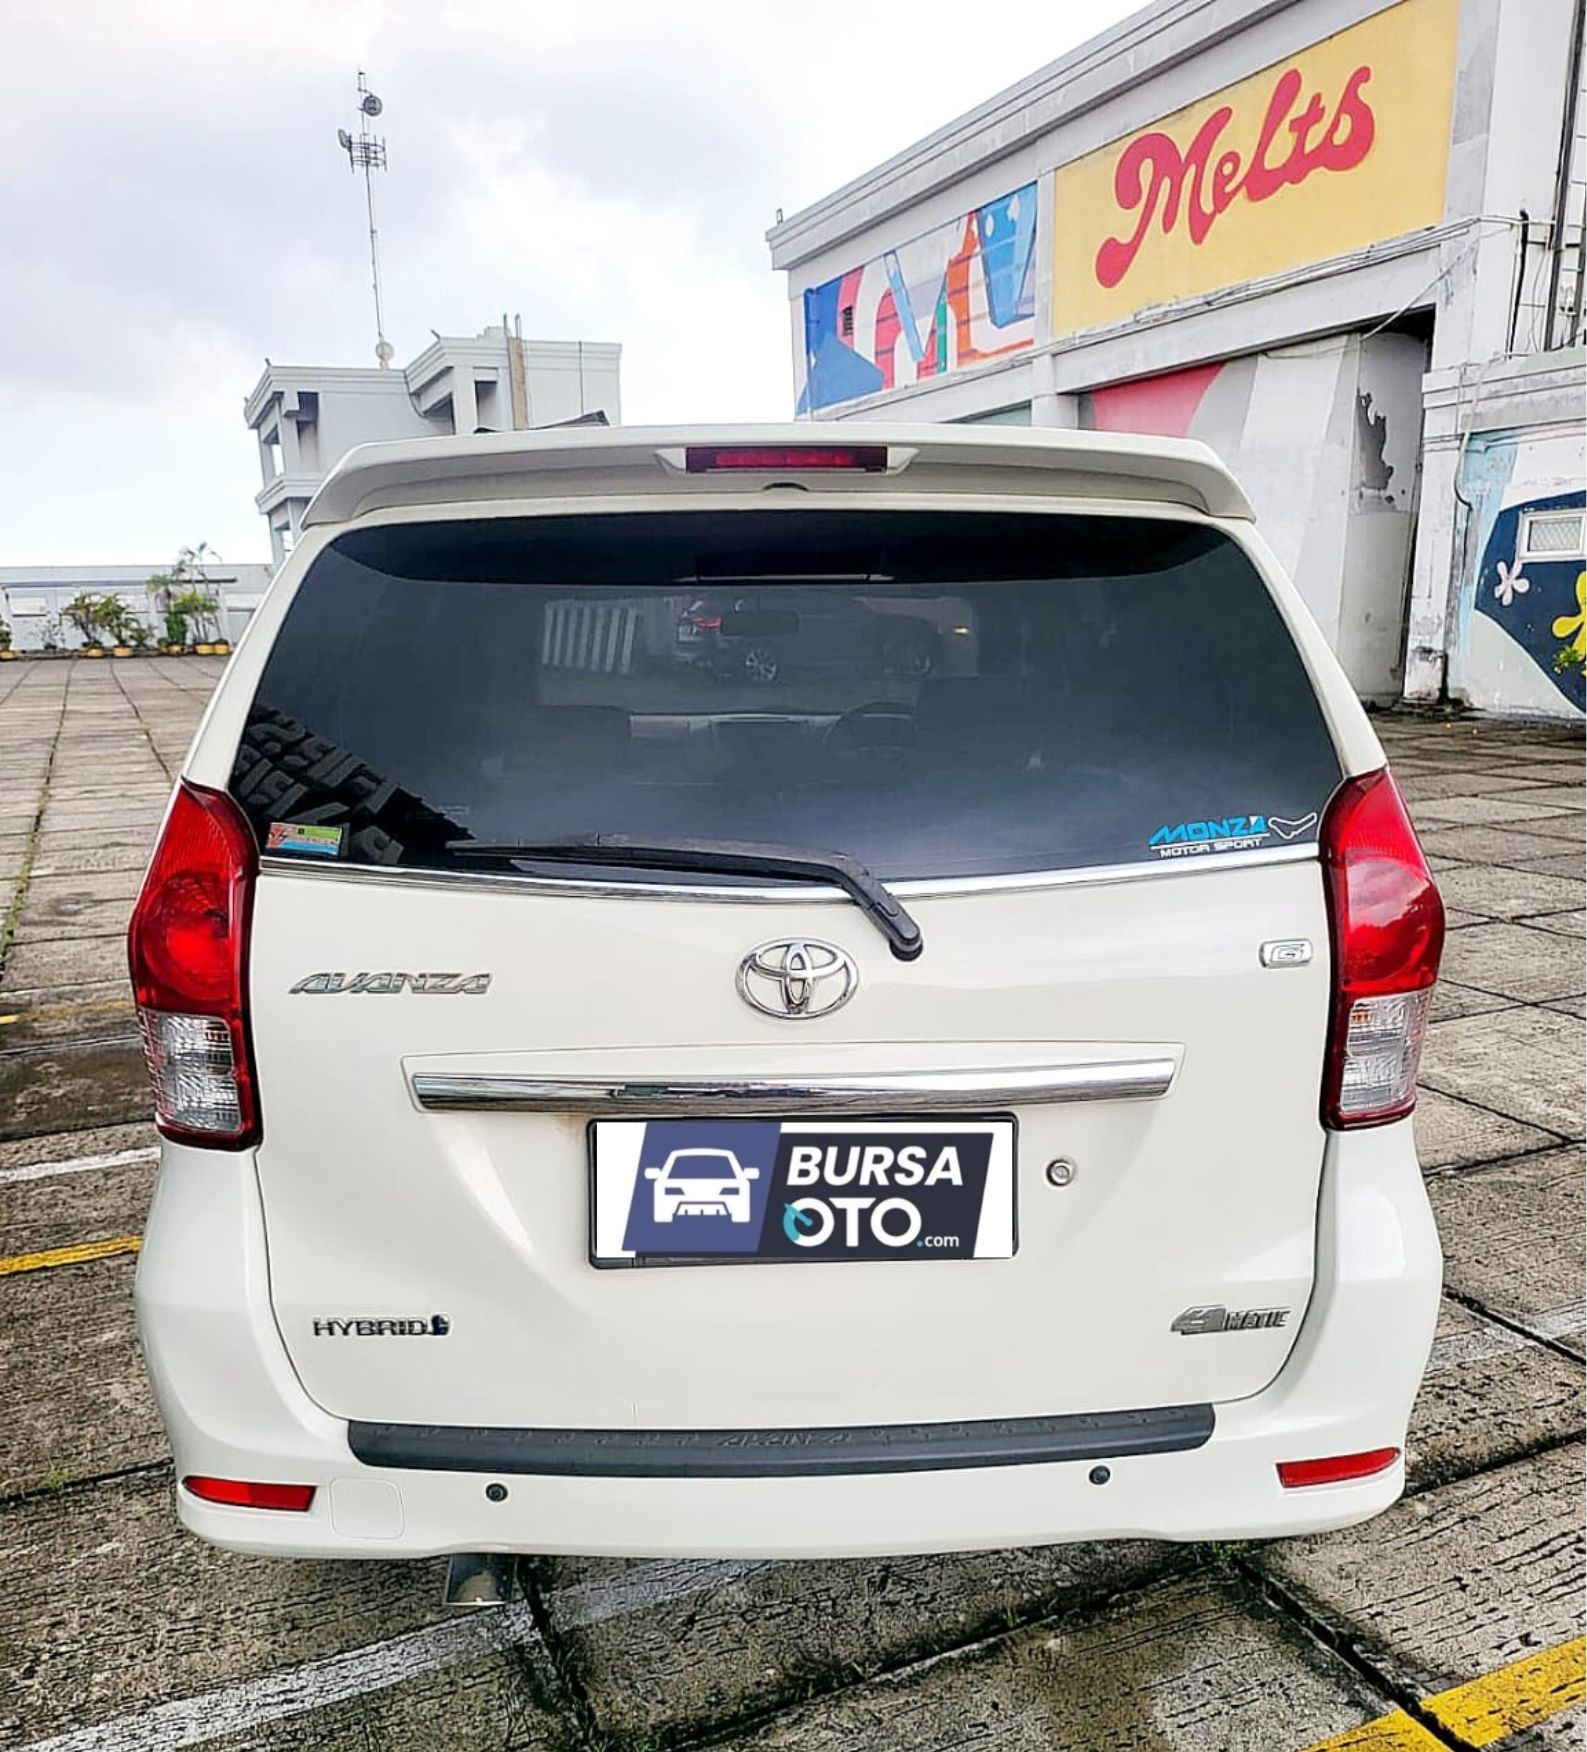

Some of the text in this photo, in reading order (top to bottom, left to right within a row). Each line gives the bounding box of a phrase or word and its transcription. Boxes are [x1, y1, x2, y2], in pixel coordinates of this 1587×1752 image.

[1096, 66, 1375, 288] Melts
[1149, 816, 1268, 845] MONZA
[1160, 838, 1263, 858] MOTOR SPORT
[289, 972, 491, 994] AVANZA
[313, 1318, 428, 1337] HYBRID
